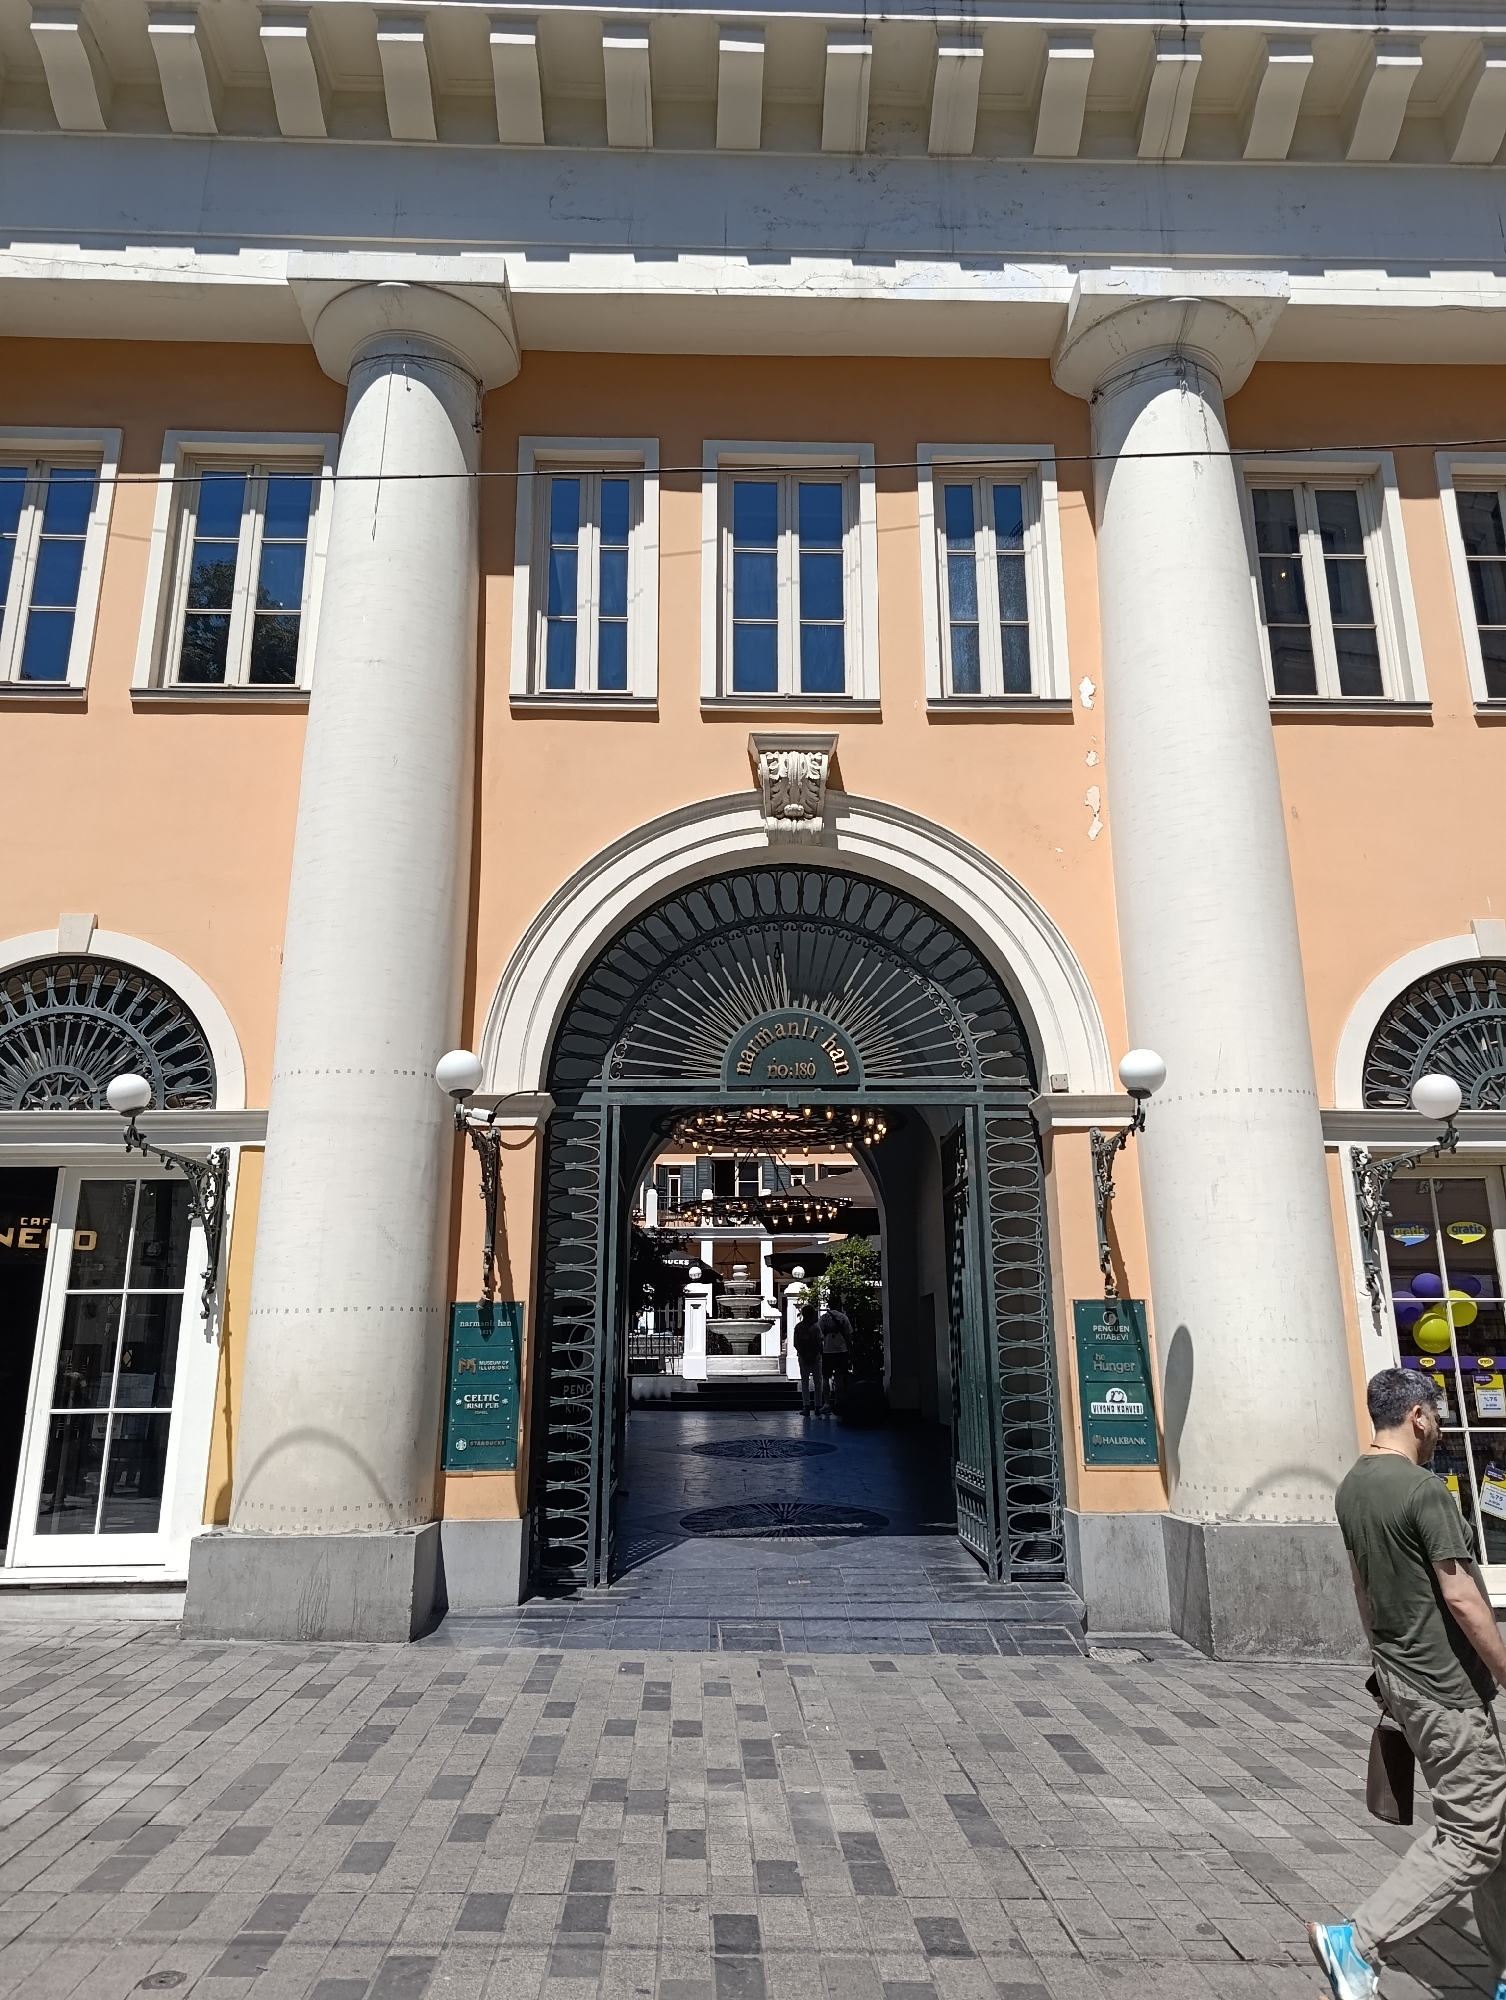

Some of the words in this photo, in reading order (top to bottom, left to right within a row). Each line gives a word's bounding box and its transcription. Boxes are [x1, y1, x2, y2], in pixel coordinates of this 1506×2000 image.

[736, 1017, 819, 1077] narmanlı
[820, 1032, 850, 1075] han
[766, 1062, 816, 1077] no:180
[20, 1217, 51, 1226] CAF
[1392, 1225, 1425, 1239] gratis
[1451, 1224, 1483, 1235] gratis
[497, 1319, 512, 1327] han
[1092, 1325, 1130, 1333] PENGUEN
[1095, 1333, 1129, 1341] KİTABEVİ
[1093, 1360, 1136, 1374] Hunger
[463, 1394, 500, 1403] CELTIC
[1102, 1436, 1147, 1446] HALKBANK
